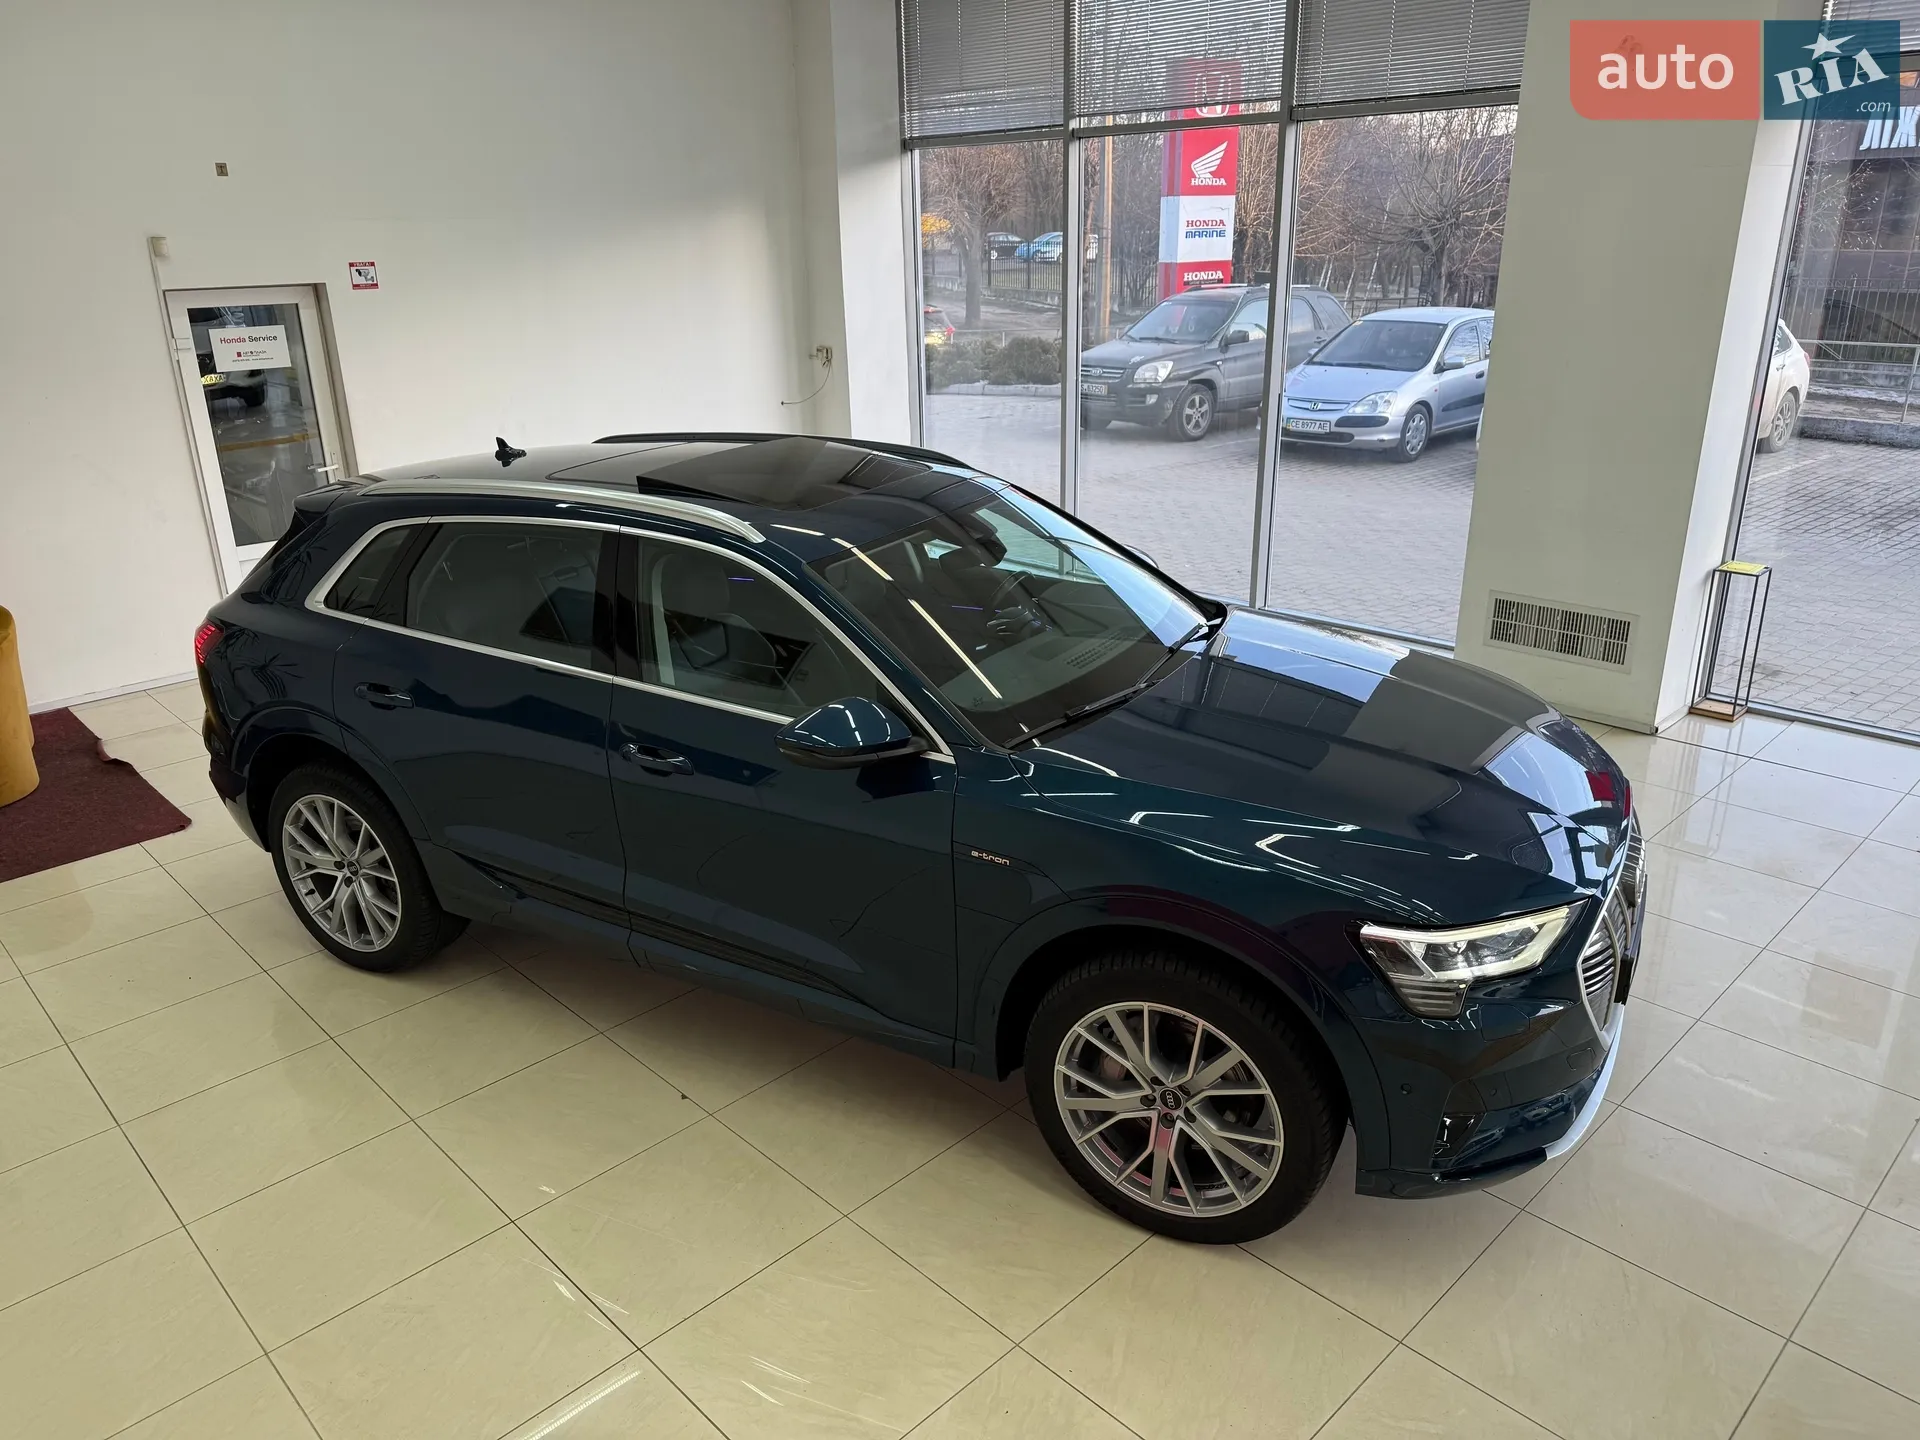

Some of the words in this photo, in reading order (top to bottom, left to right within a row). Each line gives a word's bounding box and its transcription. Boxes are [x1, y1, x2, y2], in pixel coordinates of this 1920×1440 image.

[1859, 105, 1920, 151] ЛІЖ
[1190, 177, 1227, 186] HONDA
[1186, 219, 1226, 228] HONDA
[1185, 229, 1226, 239] MARINE
[1183, 270, 1224, 281] HONDA
[219, 336, 247, 344] Honda
[247, 334, 278, 343] Service
[1290, 420, 1300, 429] CE
[1301, 421, 1317, 430] 8977
[1317, 422, 1328, 431] AE
[971, 850, 1010, 866] e-tron
